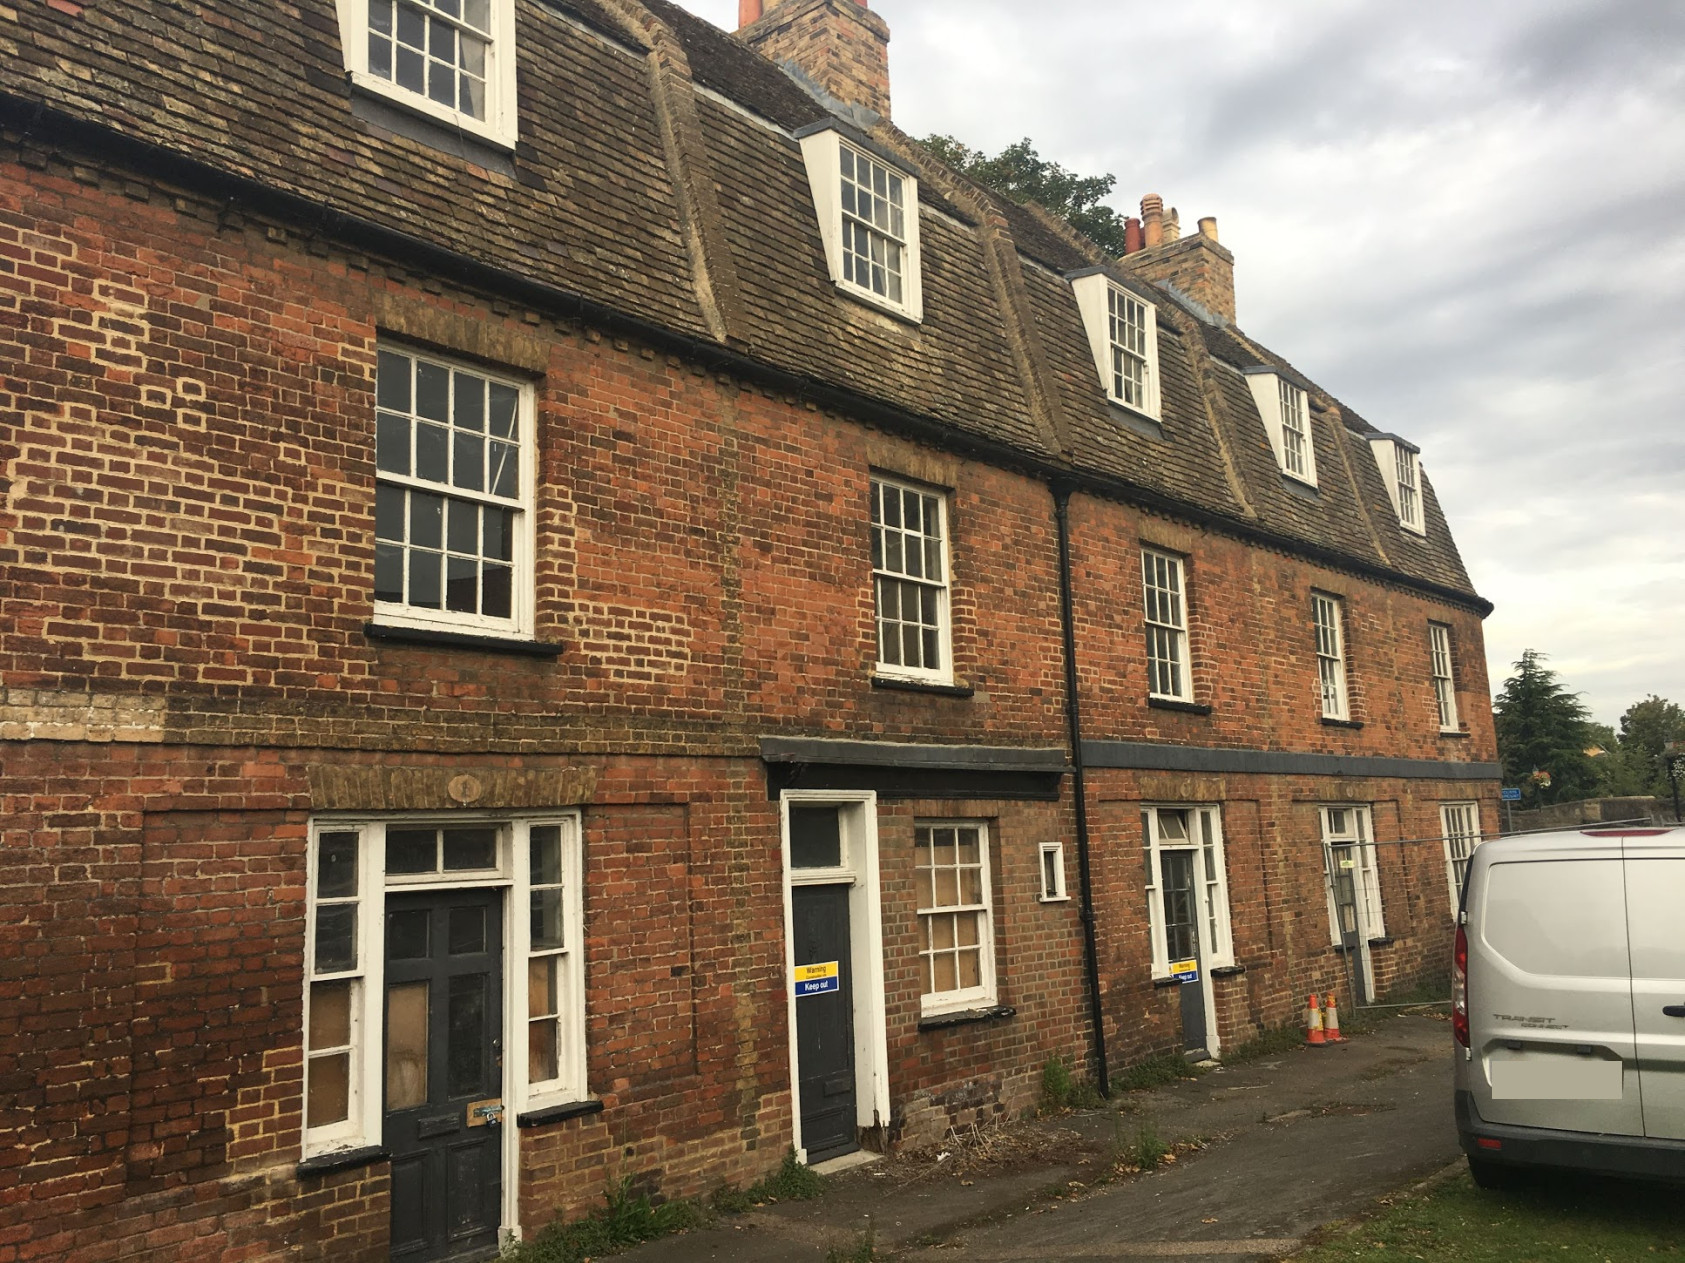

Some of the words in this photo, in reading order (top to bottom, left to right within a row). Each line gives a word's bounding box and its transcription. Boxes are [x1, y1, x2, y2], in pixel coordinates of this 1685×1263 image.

[804, 982, 819, 991] Keep
[820, 980, 828, 989] out
[1493, 1013, 1556, 1023] TRANSIT
